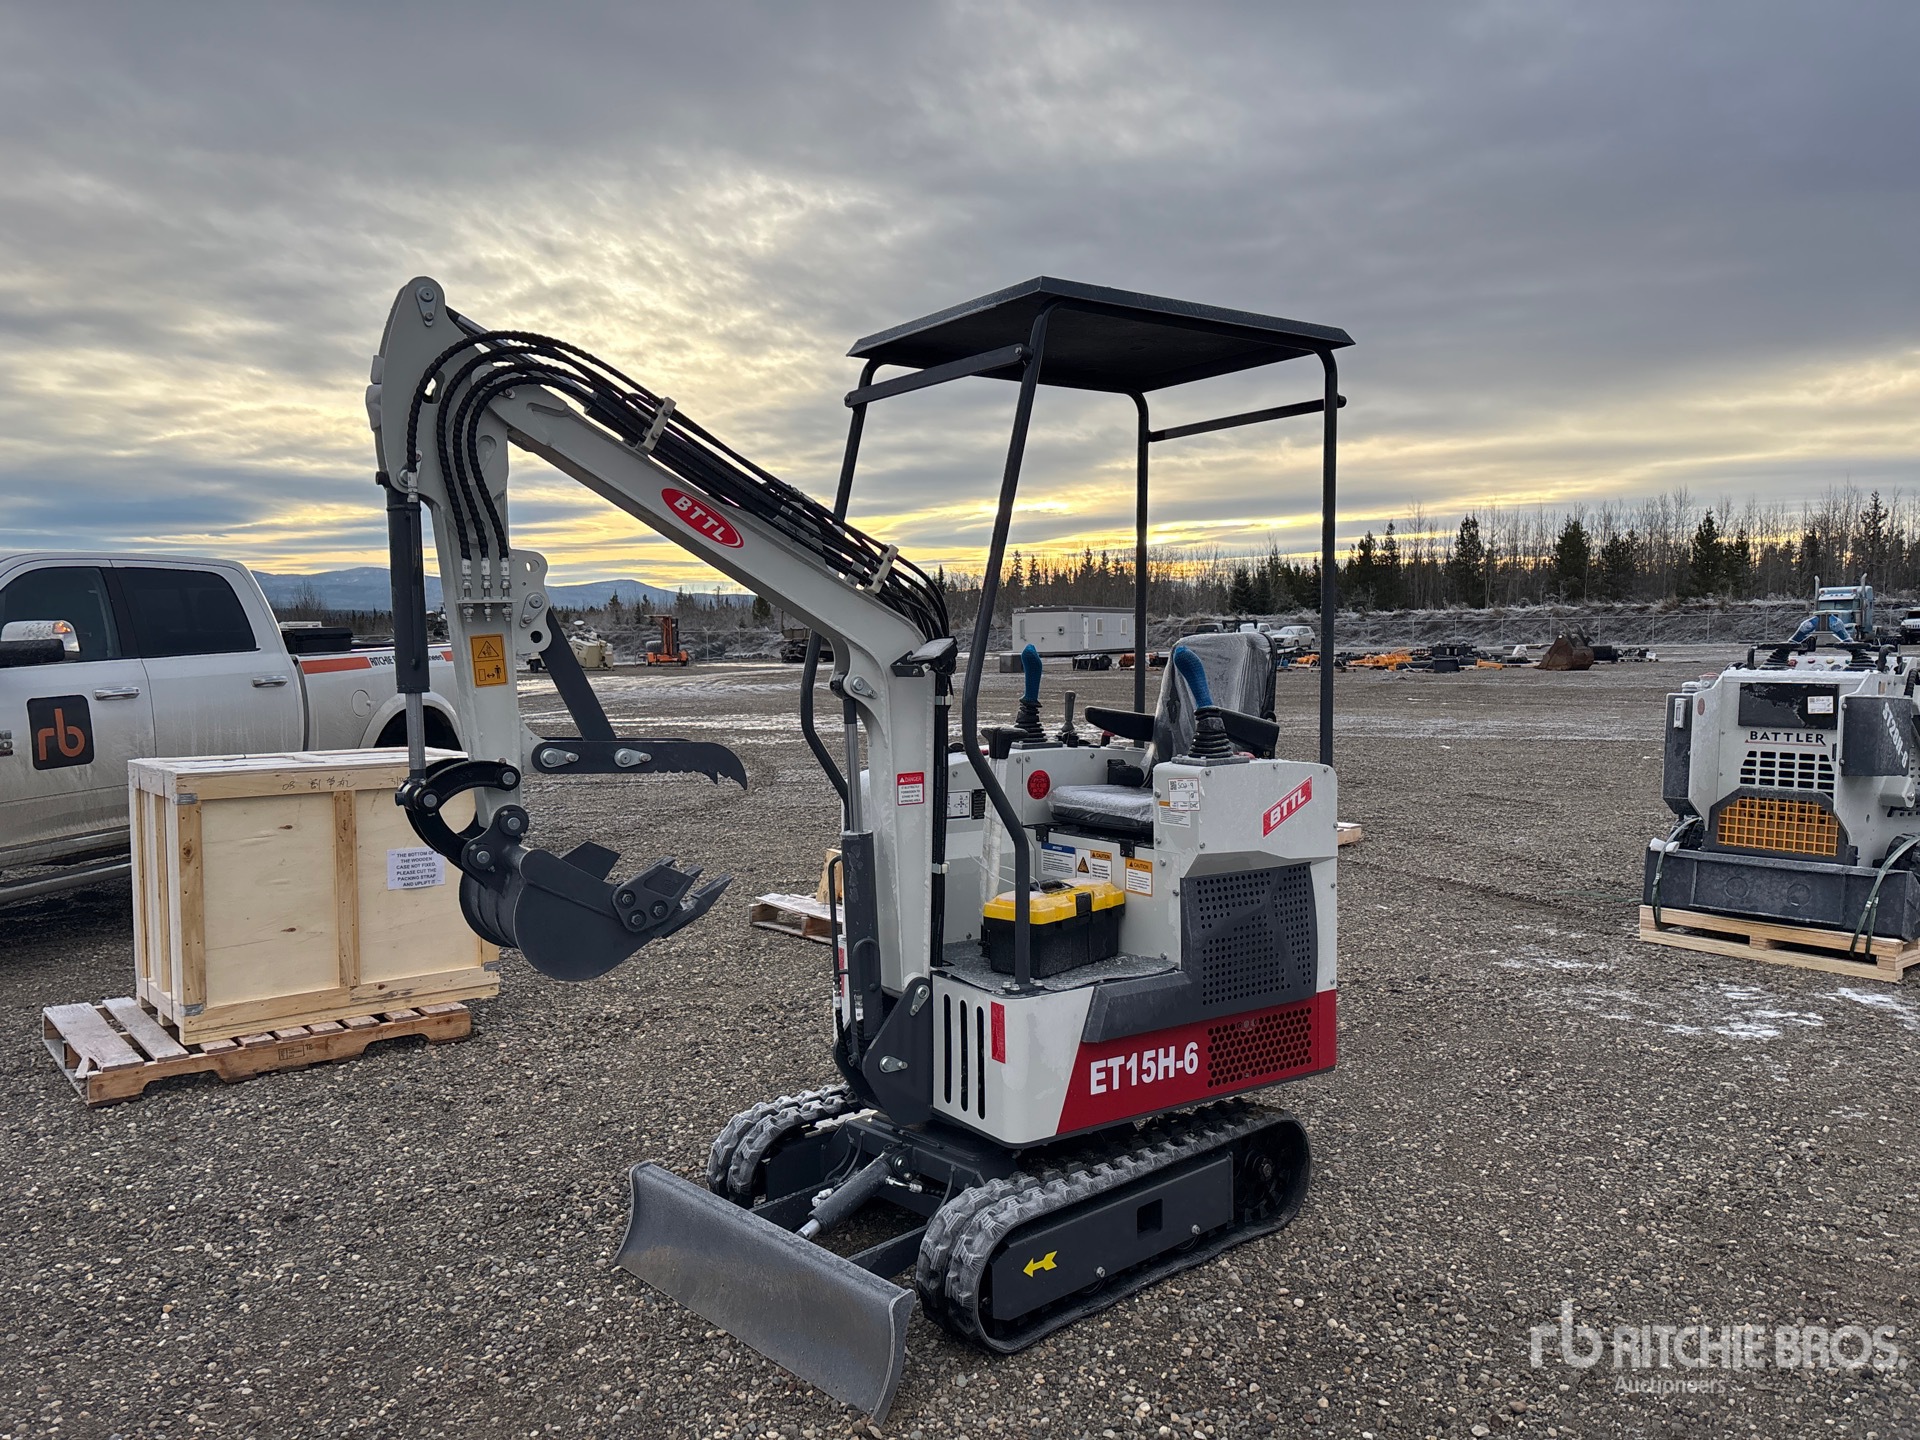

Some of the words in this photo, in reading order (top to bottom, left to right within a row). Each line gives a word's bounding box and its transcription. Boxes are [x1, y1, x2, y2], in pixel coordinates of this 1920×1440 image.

[673, 495, 726, 541] BTTL
[37, 707, 86, 761] rb
[1750, 730, 1826, 746] BATTLER
[1269, 788, 1307, 828] BTTL
[1090, 1041, 1199, 1096] ET15H-6
